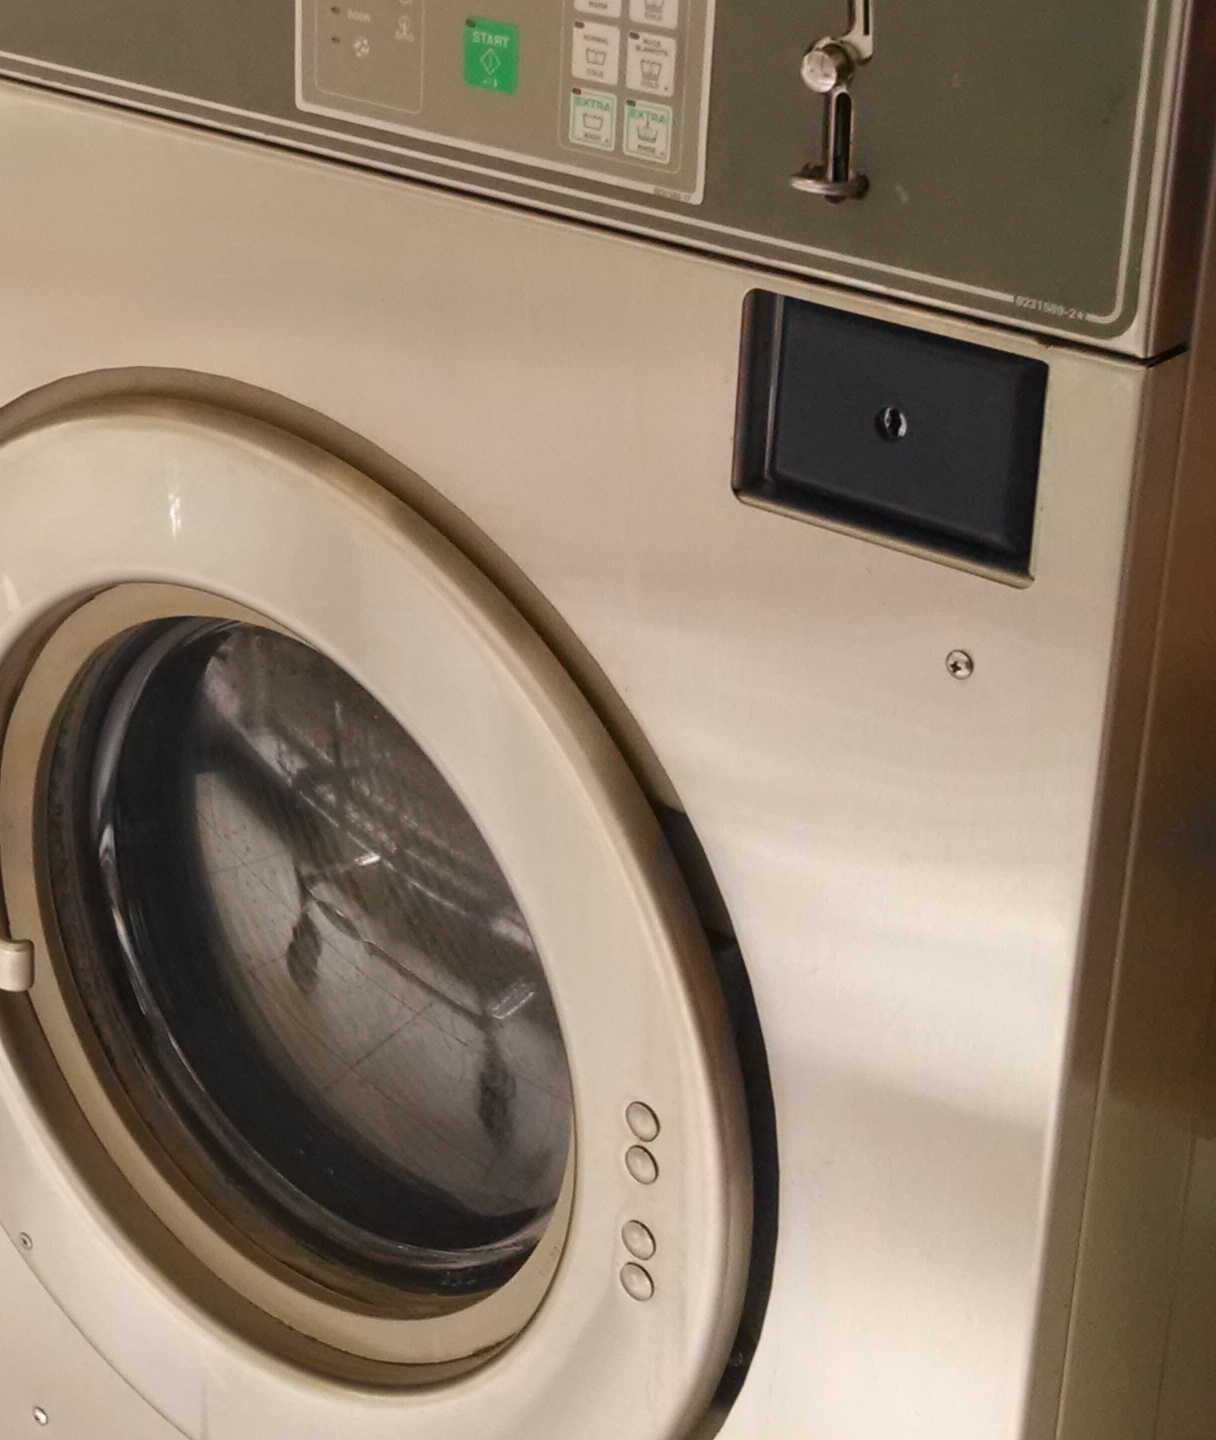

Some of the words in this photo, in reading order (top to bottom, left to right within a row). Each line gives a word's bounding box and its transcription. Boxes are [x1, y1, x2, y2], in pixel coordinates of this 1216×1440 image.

[472, 30, 510, 48] START
[575, 96, 611, 111] EXTRA
[629, 107, 667, 124] EXTRA
